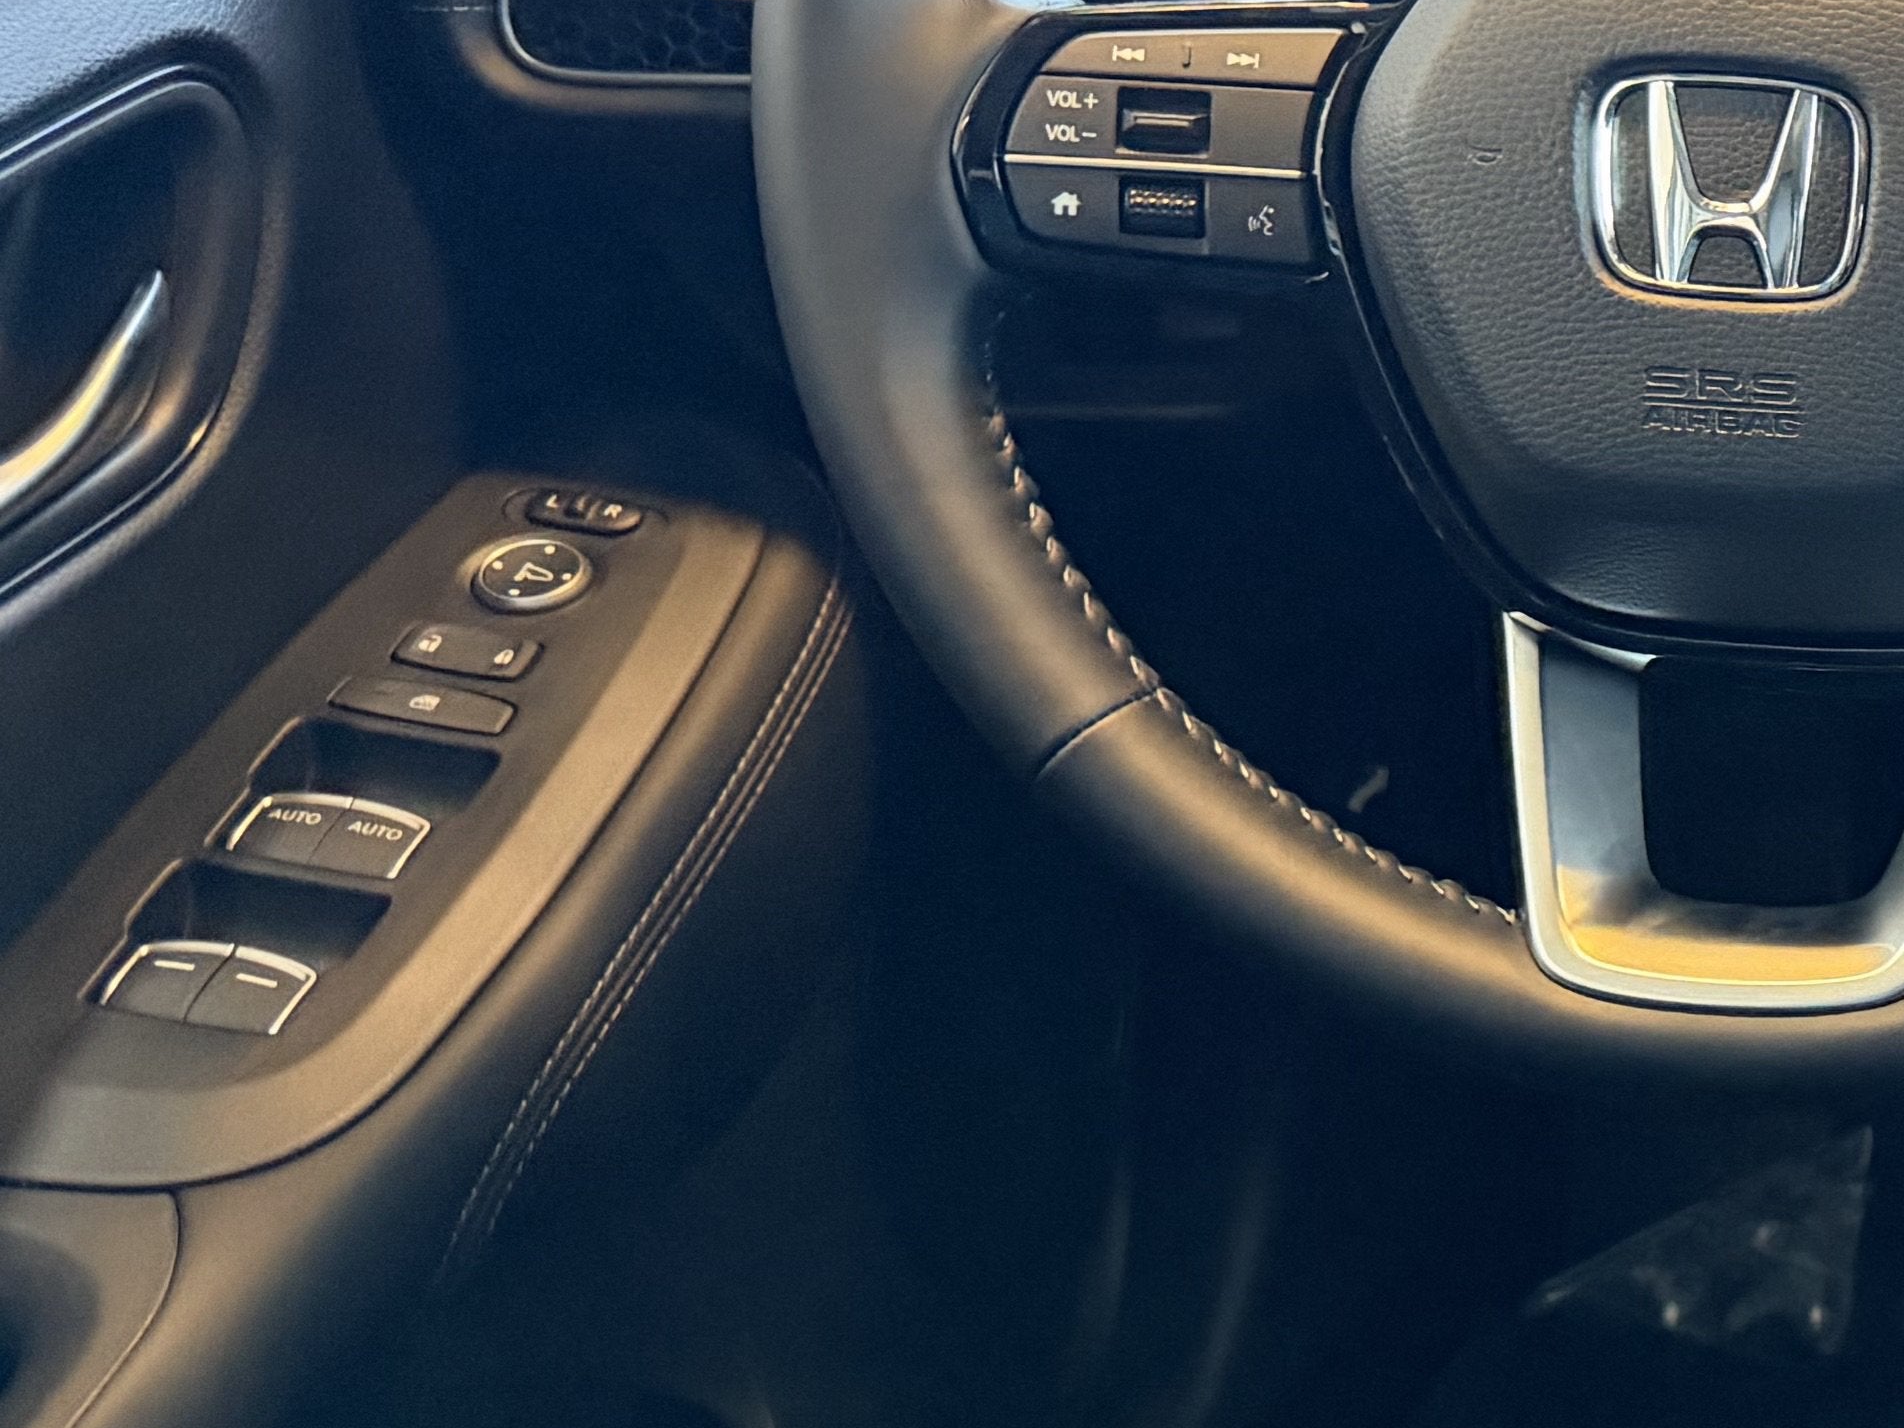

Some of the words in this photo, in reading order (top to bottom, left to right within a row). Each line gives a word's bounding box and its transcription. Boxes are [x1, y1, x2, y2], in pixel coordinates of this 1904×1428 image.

[1644, 366, 1798, 406] SRS
[1642, 410, 1804, 439] AIRBAG
[267, 808, 322, 825] AUTO
[347, 821, 403, 841] AUTO
